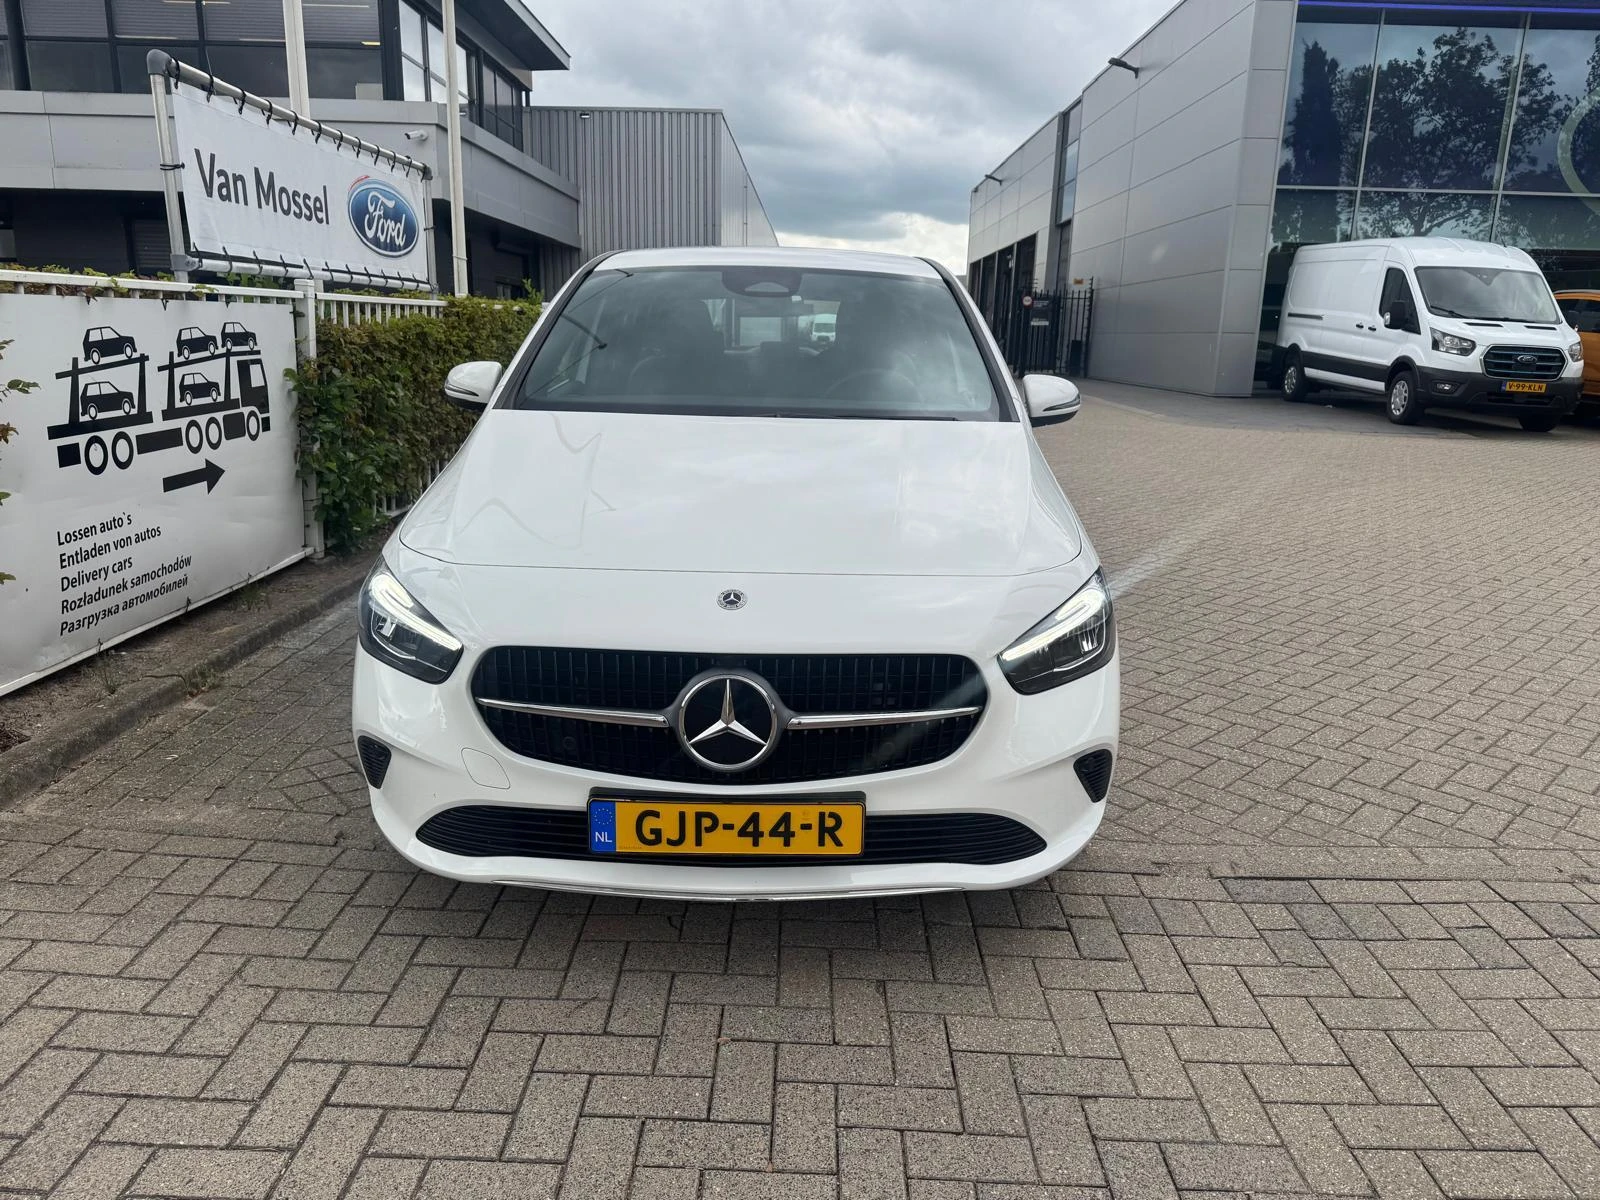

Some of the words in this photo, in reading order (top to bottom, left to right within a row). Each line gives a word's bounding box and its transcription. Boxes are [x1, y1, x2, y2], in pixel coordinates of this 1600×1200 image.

[195, 148, 248, 206] Van
[253, 167, 330, 225] Mossel
[364, 191, 407, 246] Ford
[1508, 382, 1544, 391] V-99-KLN
[57, 524, 98, 546] Lossen
[59, 542, 111, 570] Entladen
[112, 535, 133, 551] von
[134, 526, 161, 544] autos
[60, 565, 109, 592] Delivery
[111, 556, 133, 574] cars
[61, 577, 129, 615] Rozładunek
[130, 555, 192, 589] samochodów
[60, 604, 119, 637] Разгрузка
[121, 573, 188, 611] автомобилей
[595, 831, 613, 843] NL
[635, 809, 843, 847] GJP-44-R
